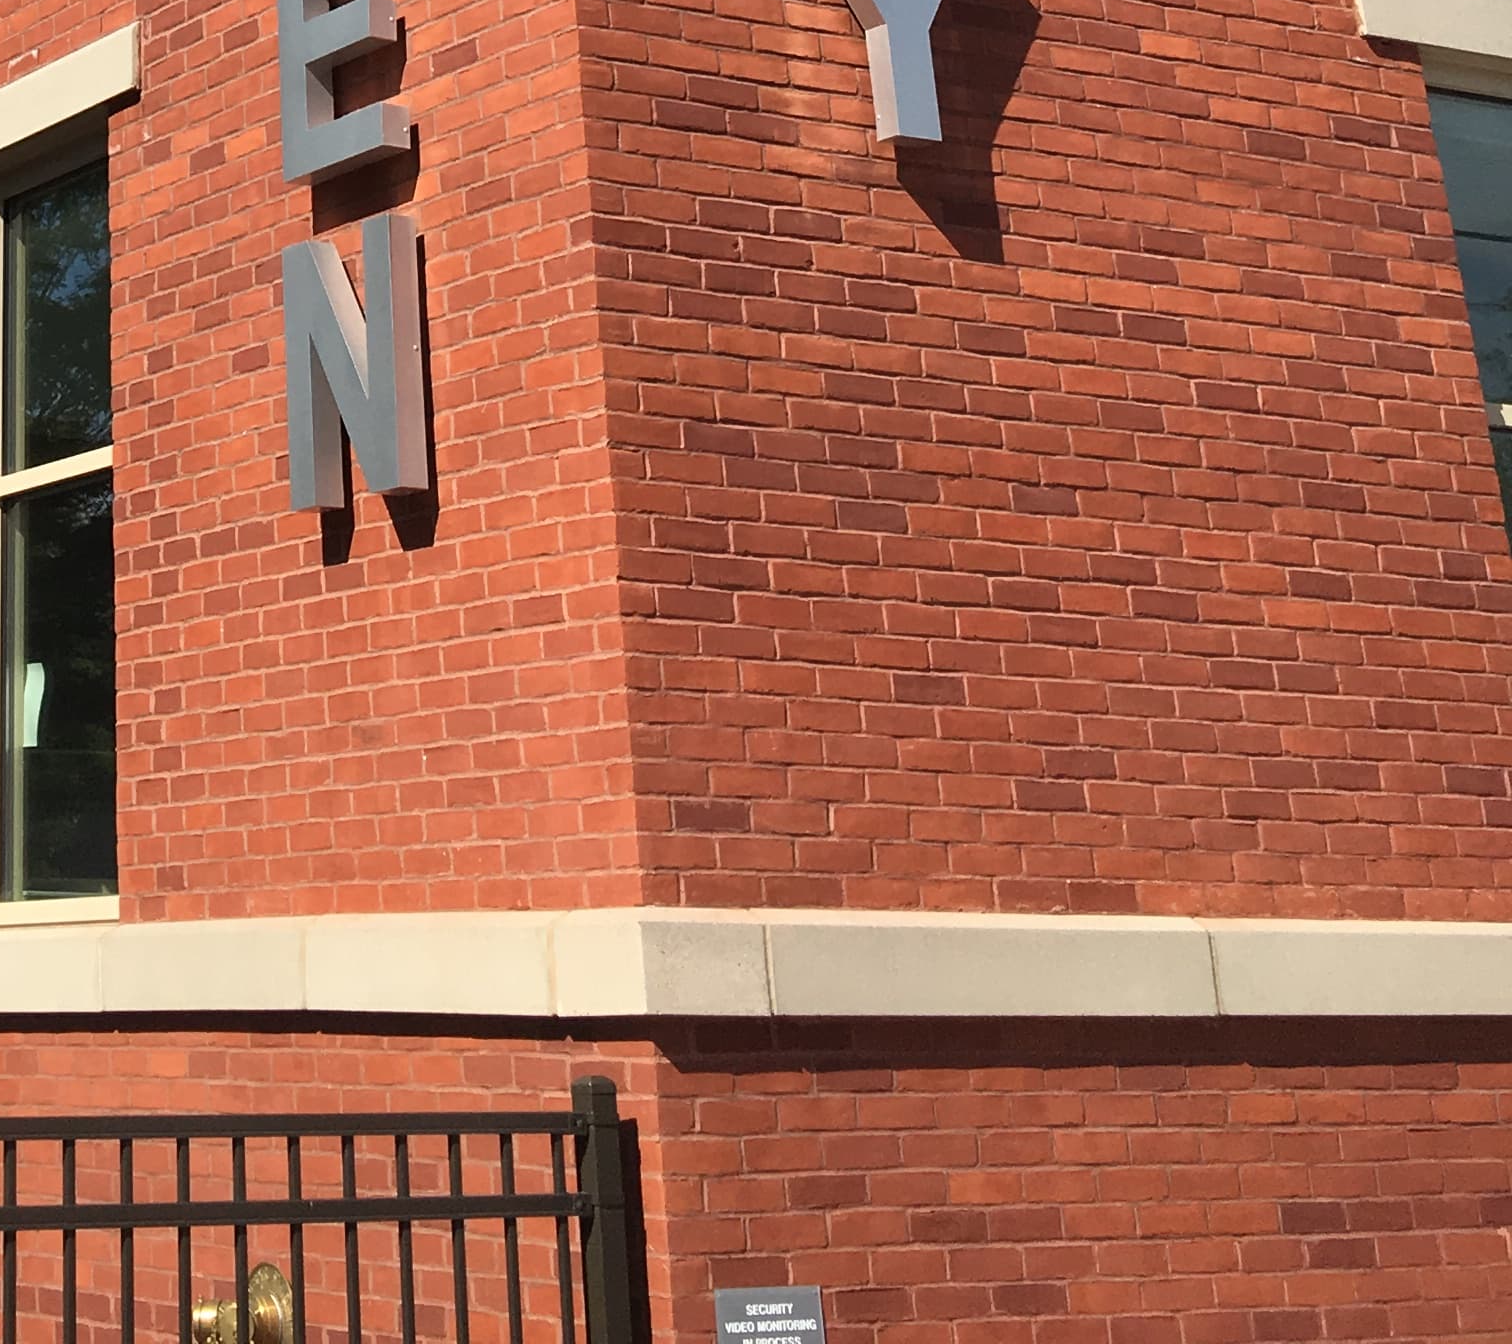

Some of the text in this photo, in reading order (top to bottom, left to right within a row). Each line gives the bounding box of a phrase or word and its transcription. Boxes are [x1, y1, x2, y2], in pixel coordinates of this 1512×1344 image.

[745, 1302, 794, 1316] SECURITY
[724, 1318, 818, 1334] VIDEO MONITORING
